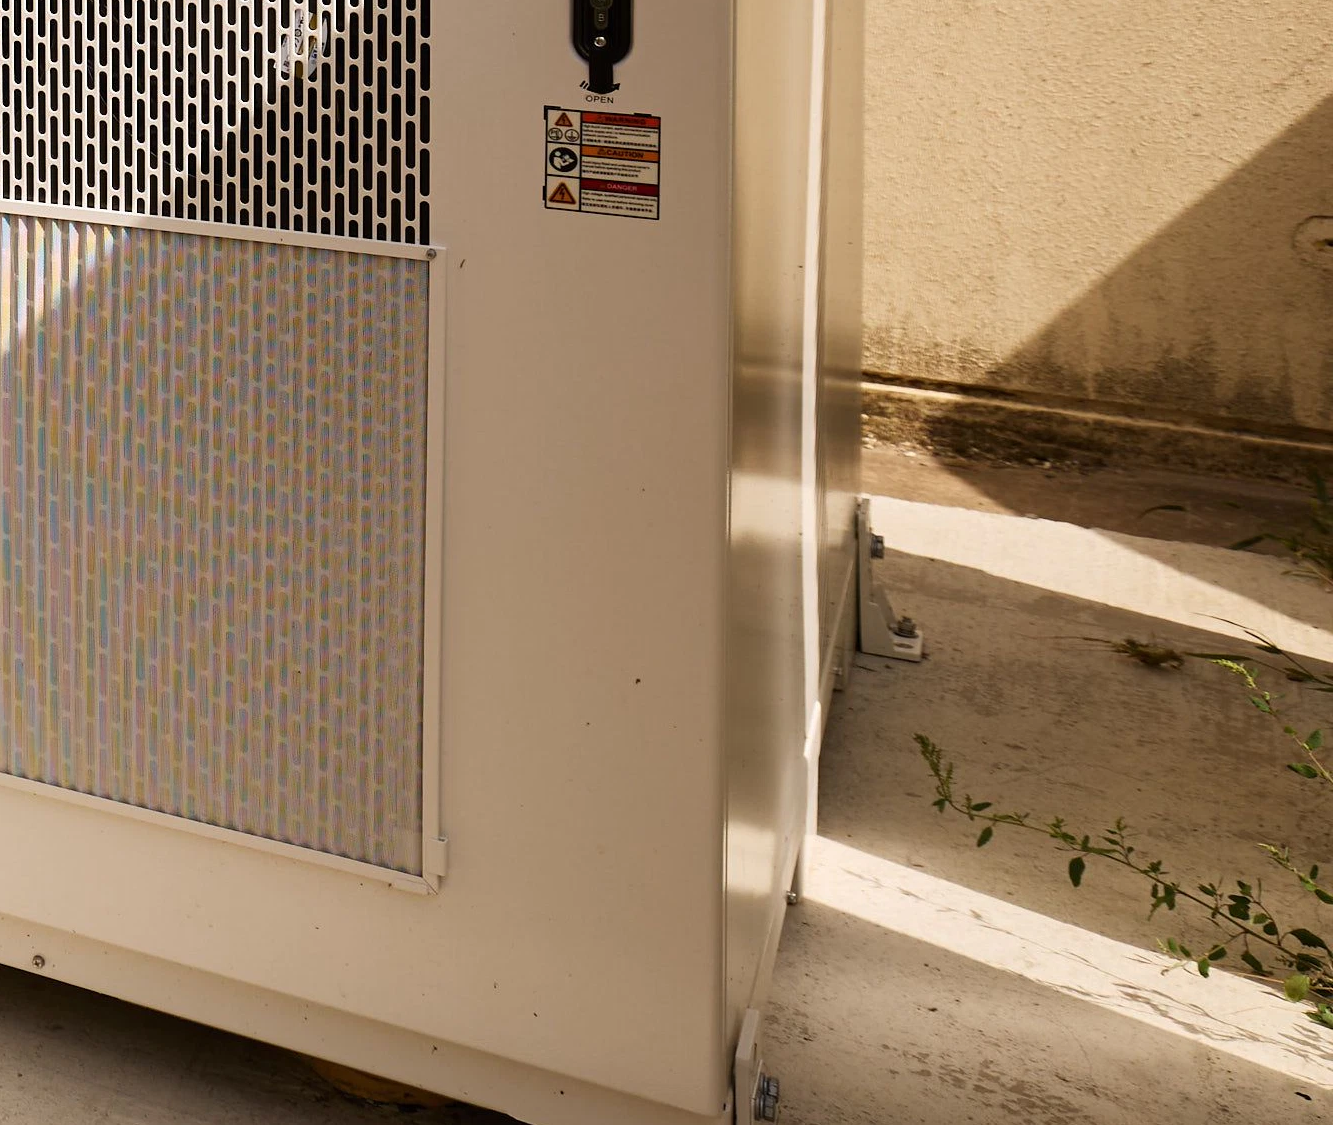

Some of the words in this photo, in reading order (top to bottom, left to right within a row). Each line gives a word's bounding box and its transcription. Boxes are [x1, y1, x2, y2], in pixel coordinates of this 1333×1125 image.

[585, 95, 614, 104] OPEN
[604, 116, 646, 125] WARNING
[606, 149, 644, 159] CAUTION
[607, 183, 637, 191] DANGER
